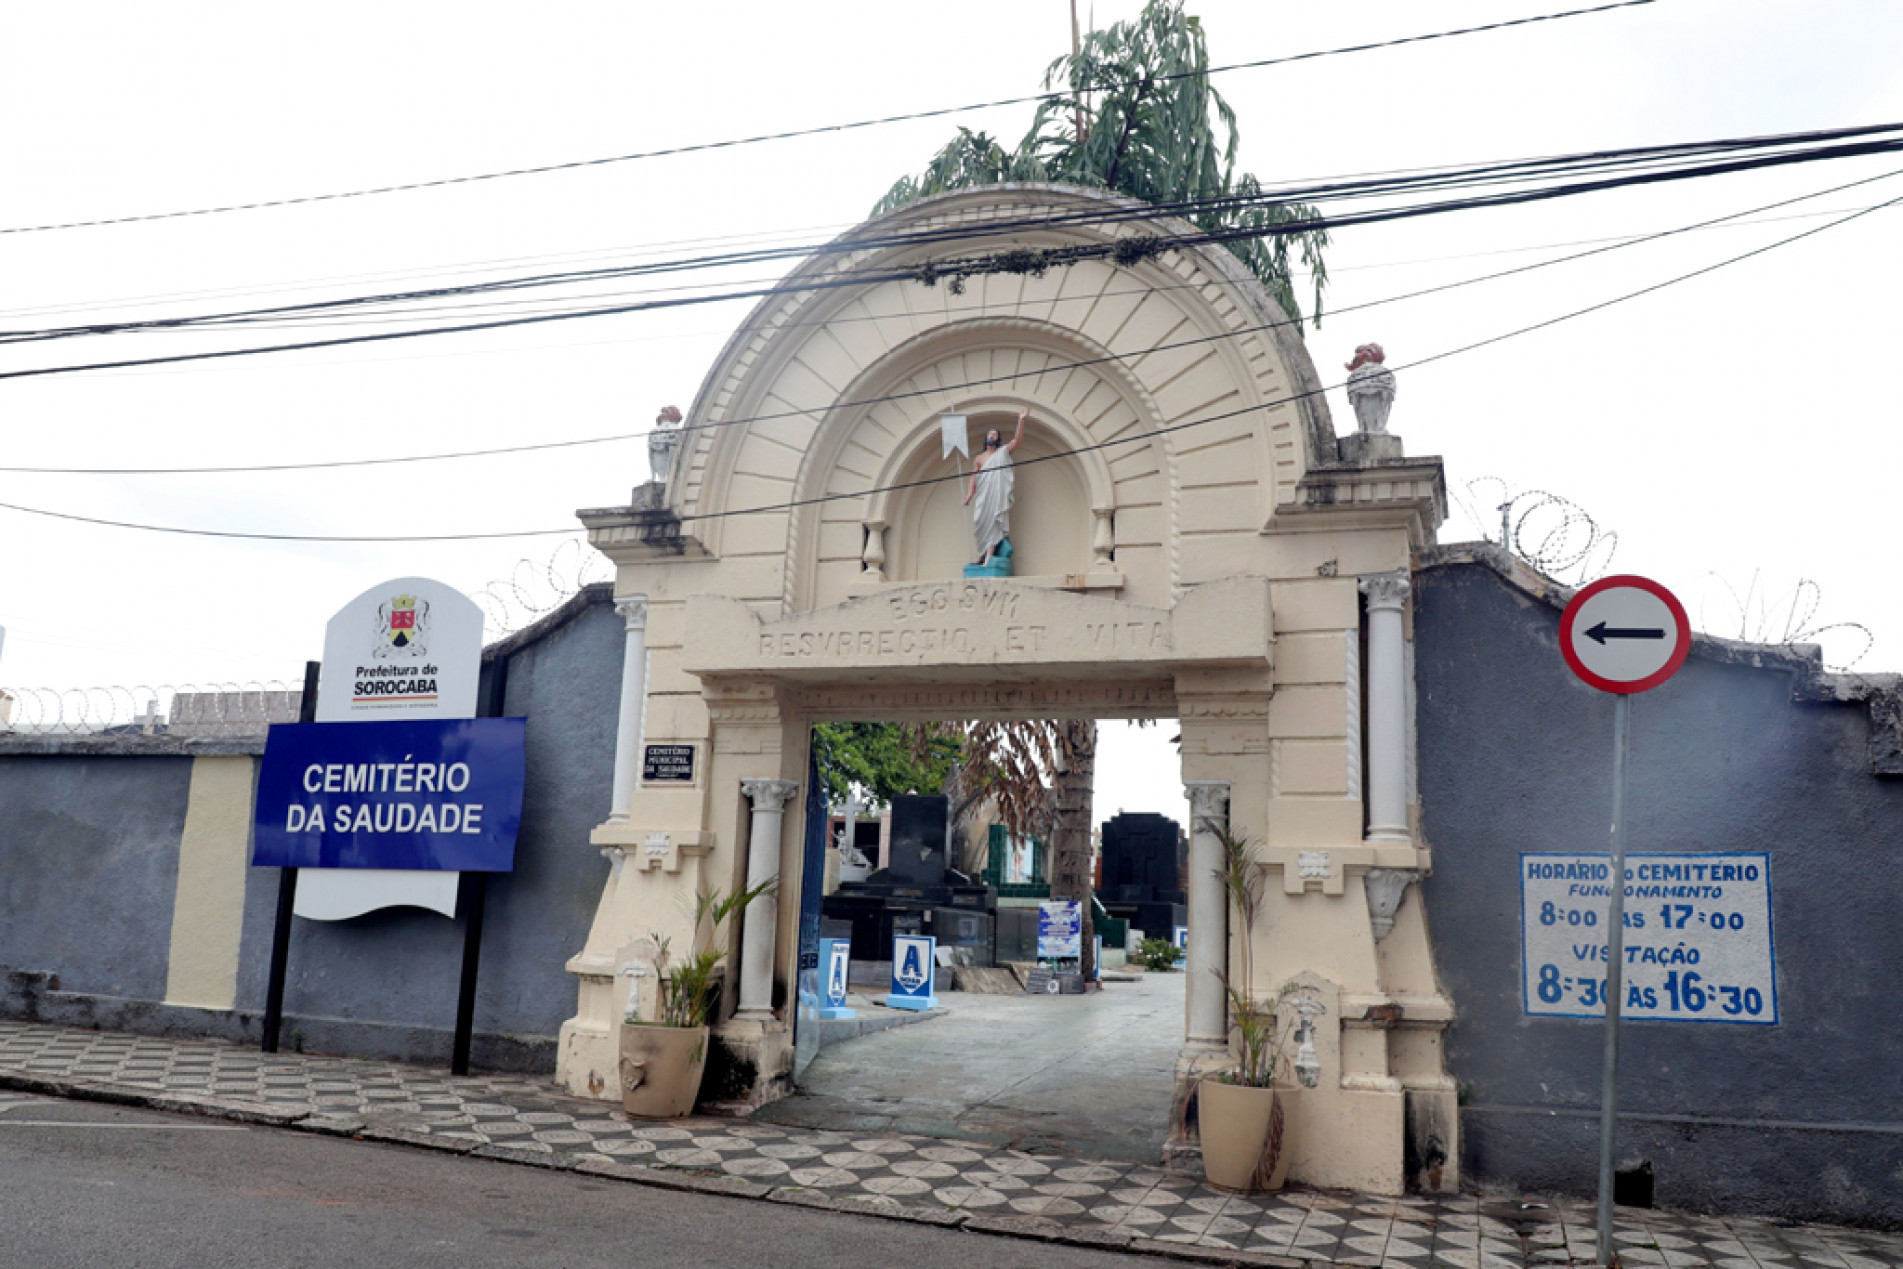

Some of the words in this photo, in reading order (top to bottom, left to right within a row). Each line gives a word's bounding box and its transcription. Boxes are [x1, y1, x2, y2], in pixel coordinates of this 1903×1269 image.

[1006, 625, 1046, 651] ET
[355, 664, 419, 677] Prefeitura
[421, 663, 438, 675] de
[354, 678, 438, 695] SOROCABA
[303, 754, 471, 793] CEMITÉRIO
[286, 804, 326, 833] DA
[333, 804, 483, 834] SAUDADE
[1528, 859, 1609, 880] HORÁRIO
[1638, 861, 1759, 882] CEMITÉRIO
[1568, 883, 1722, 899] FUNCONAMENTO
[1539, 901, 1597, 926] 8:00
[1659, 904, 1744, 930] 17:00
[1571, 942, 1700, 967] VISTAÇÃO
[1626, 979, 1658, 1009] ÀS
[1663, 971, 1763, 1015] 16:30
